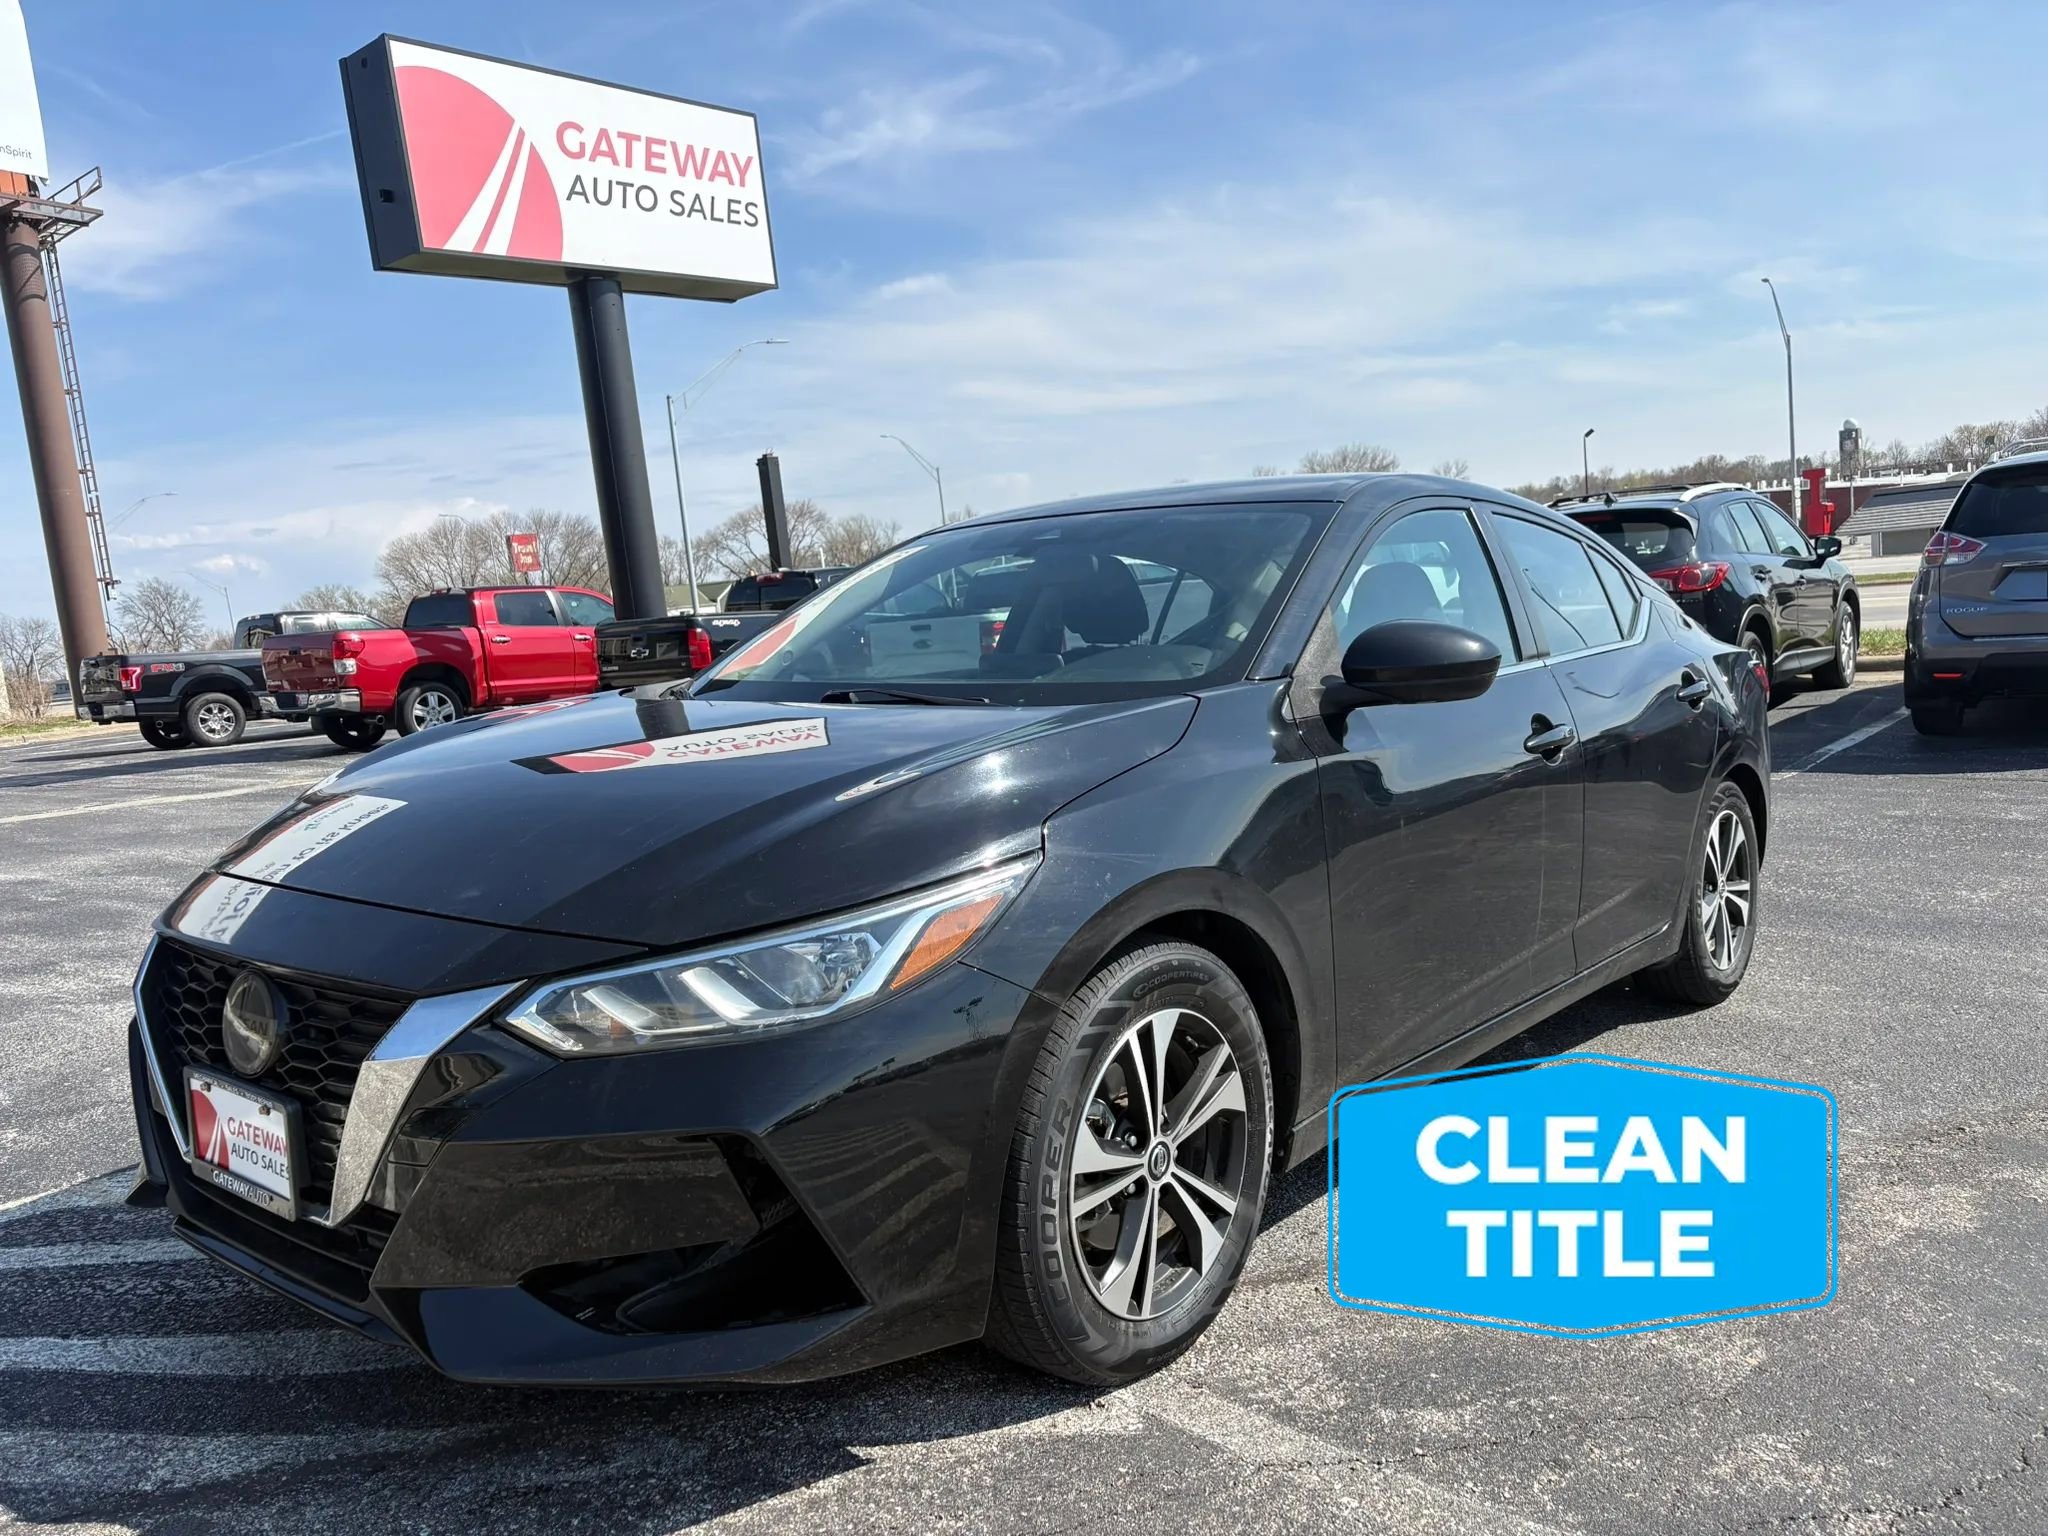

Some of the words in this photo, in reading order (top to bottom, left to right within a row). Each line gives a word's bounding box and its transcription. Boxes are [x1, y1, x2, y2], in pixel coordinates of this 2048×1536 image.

[555, 121, 754, 188] GATEWAY
[565, 174, 658, 212] AUTO
[669, 189, 759, 228] SALES
[227, 1116, 288, 1157] GATEWAY
[231, 1143, 259, 1165] AUTO
[261, 1154, 290, 1181] SALES
[212, 1170, 250, 1198] GATEWAY
[248, 1187, 271, 1207] AUTO
